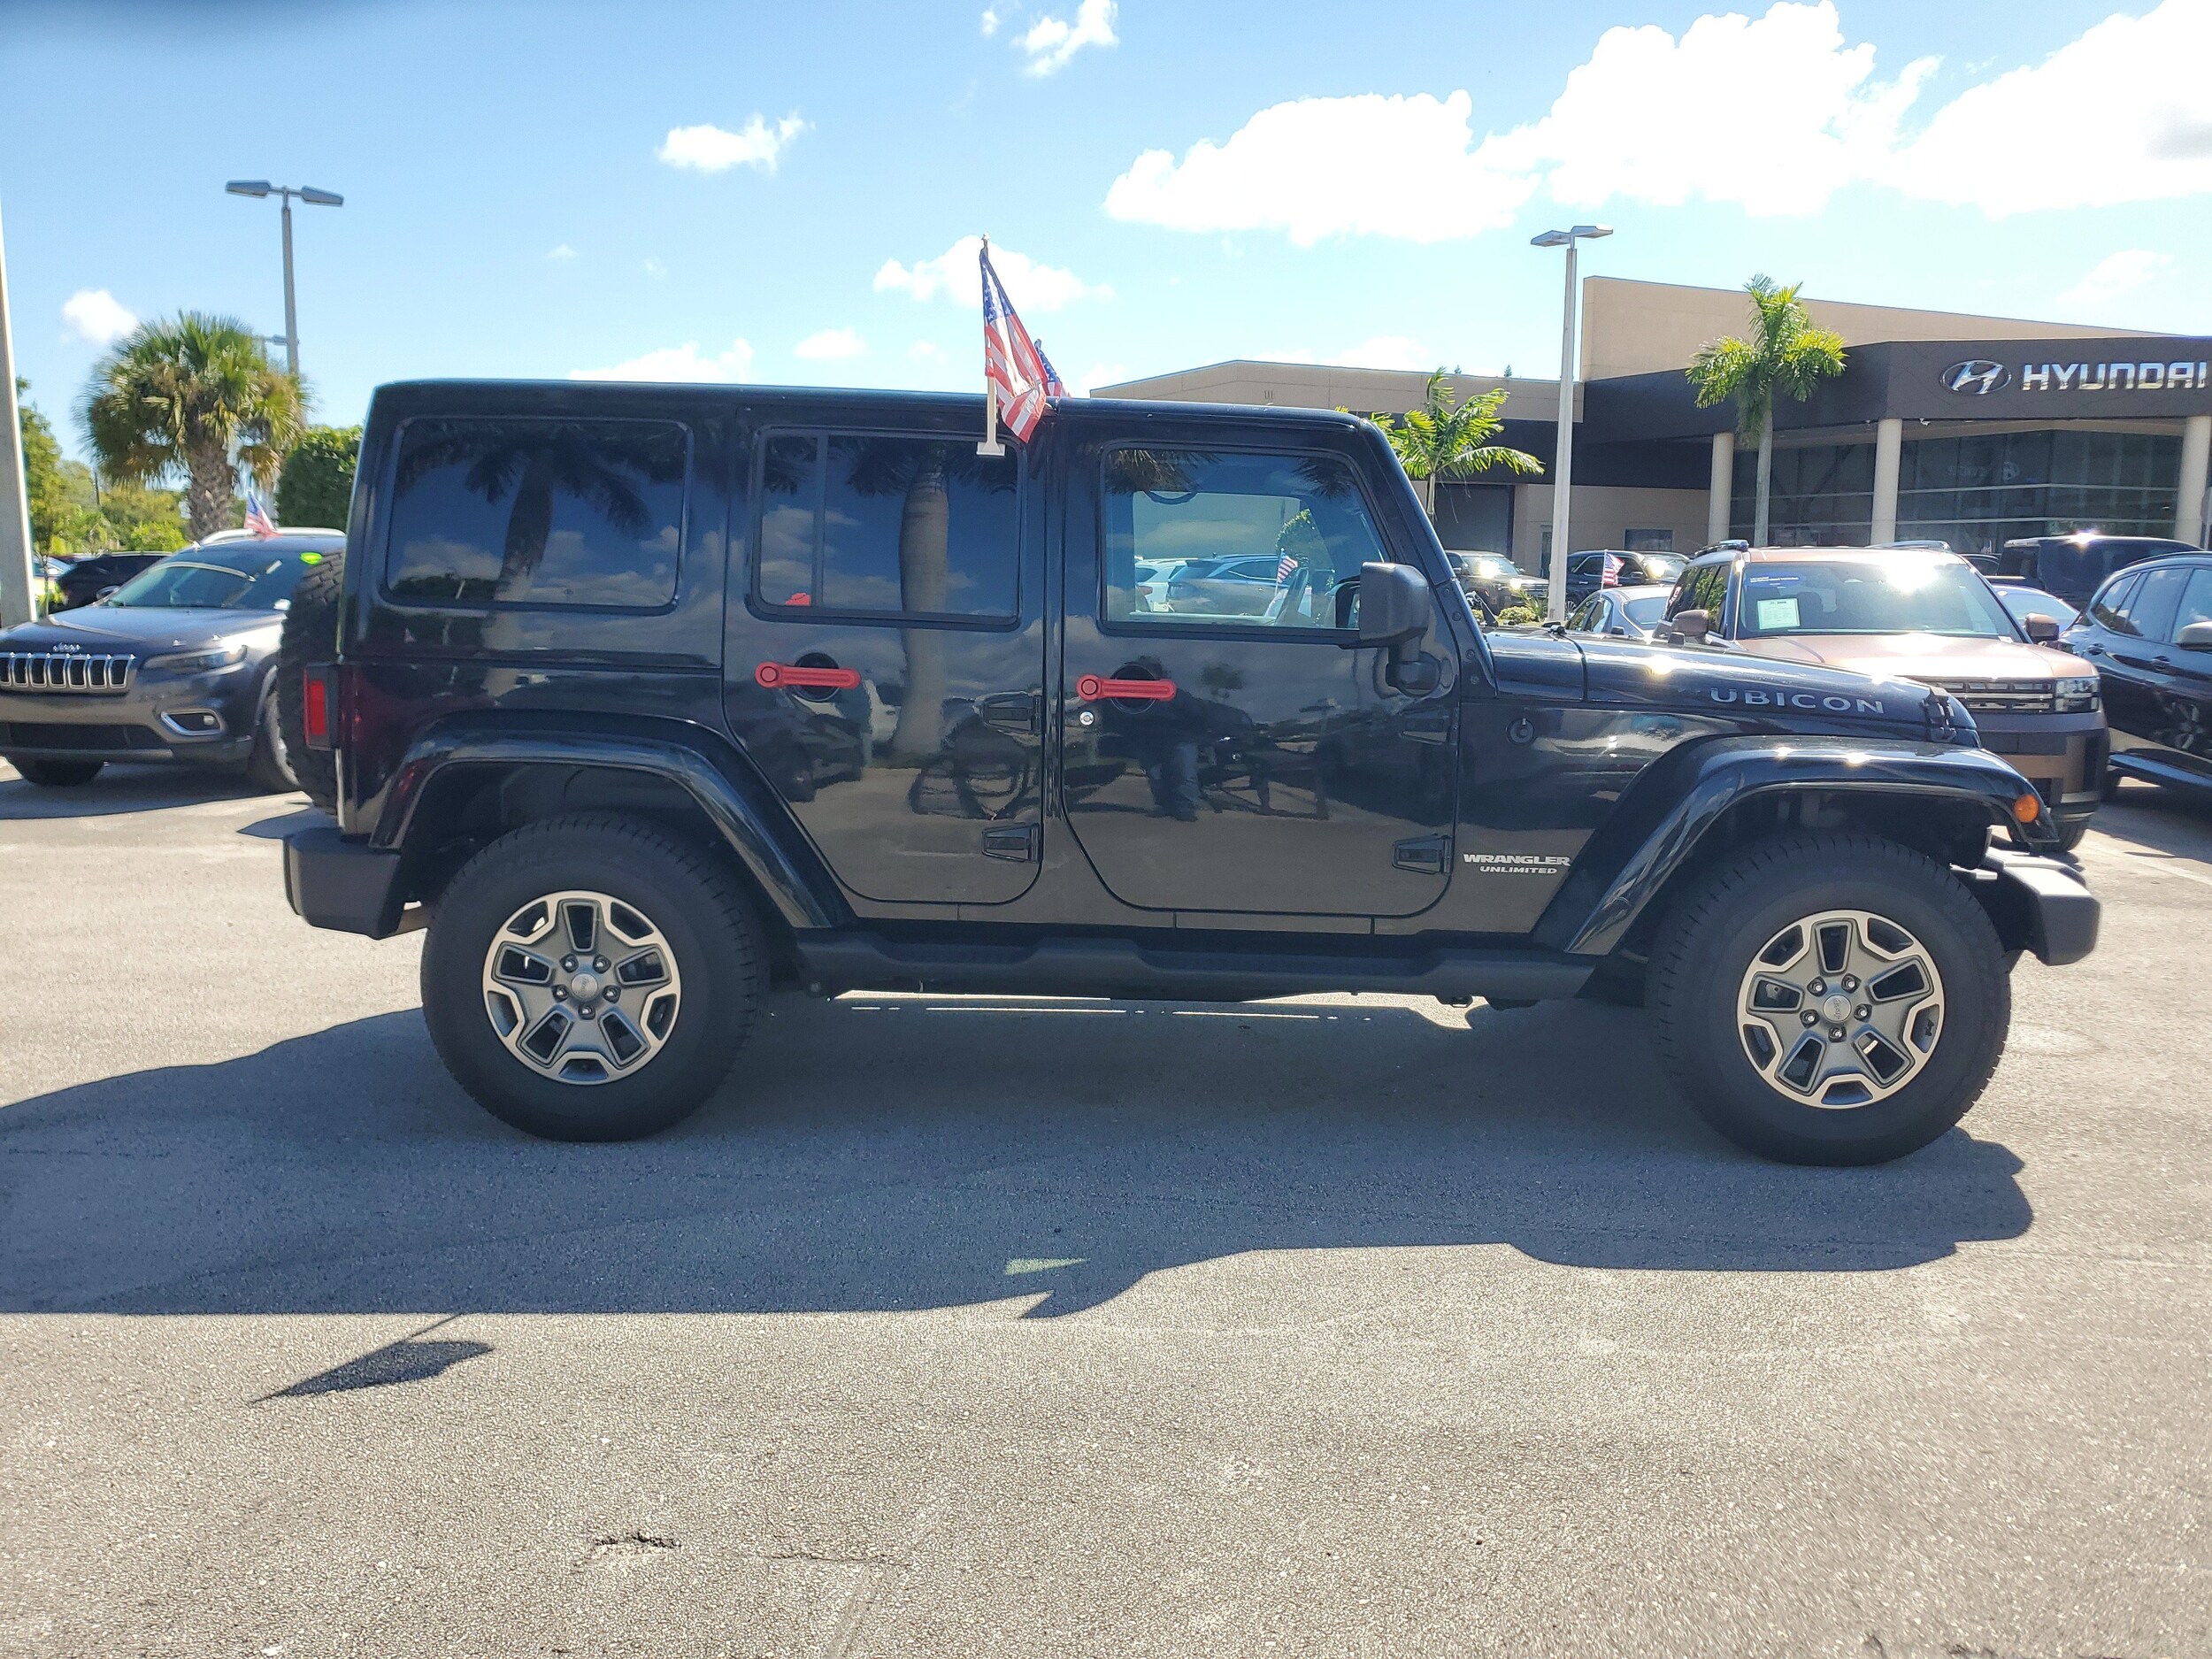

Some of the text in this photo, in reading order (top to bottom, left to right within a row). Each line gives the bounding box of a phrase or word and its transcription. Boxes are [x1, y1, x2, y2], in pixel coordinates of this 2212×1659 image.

[2021, 361, 2208, 391] HYUNDAI
[1709, 687, 1885, 715] UBICON
[1463, 853, 1571, 867] WRANGLER
[1479, 865, 1557, 874] UNLIMITED
